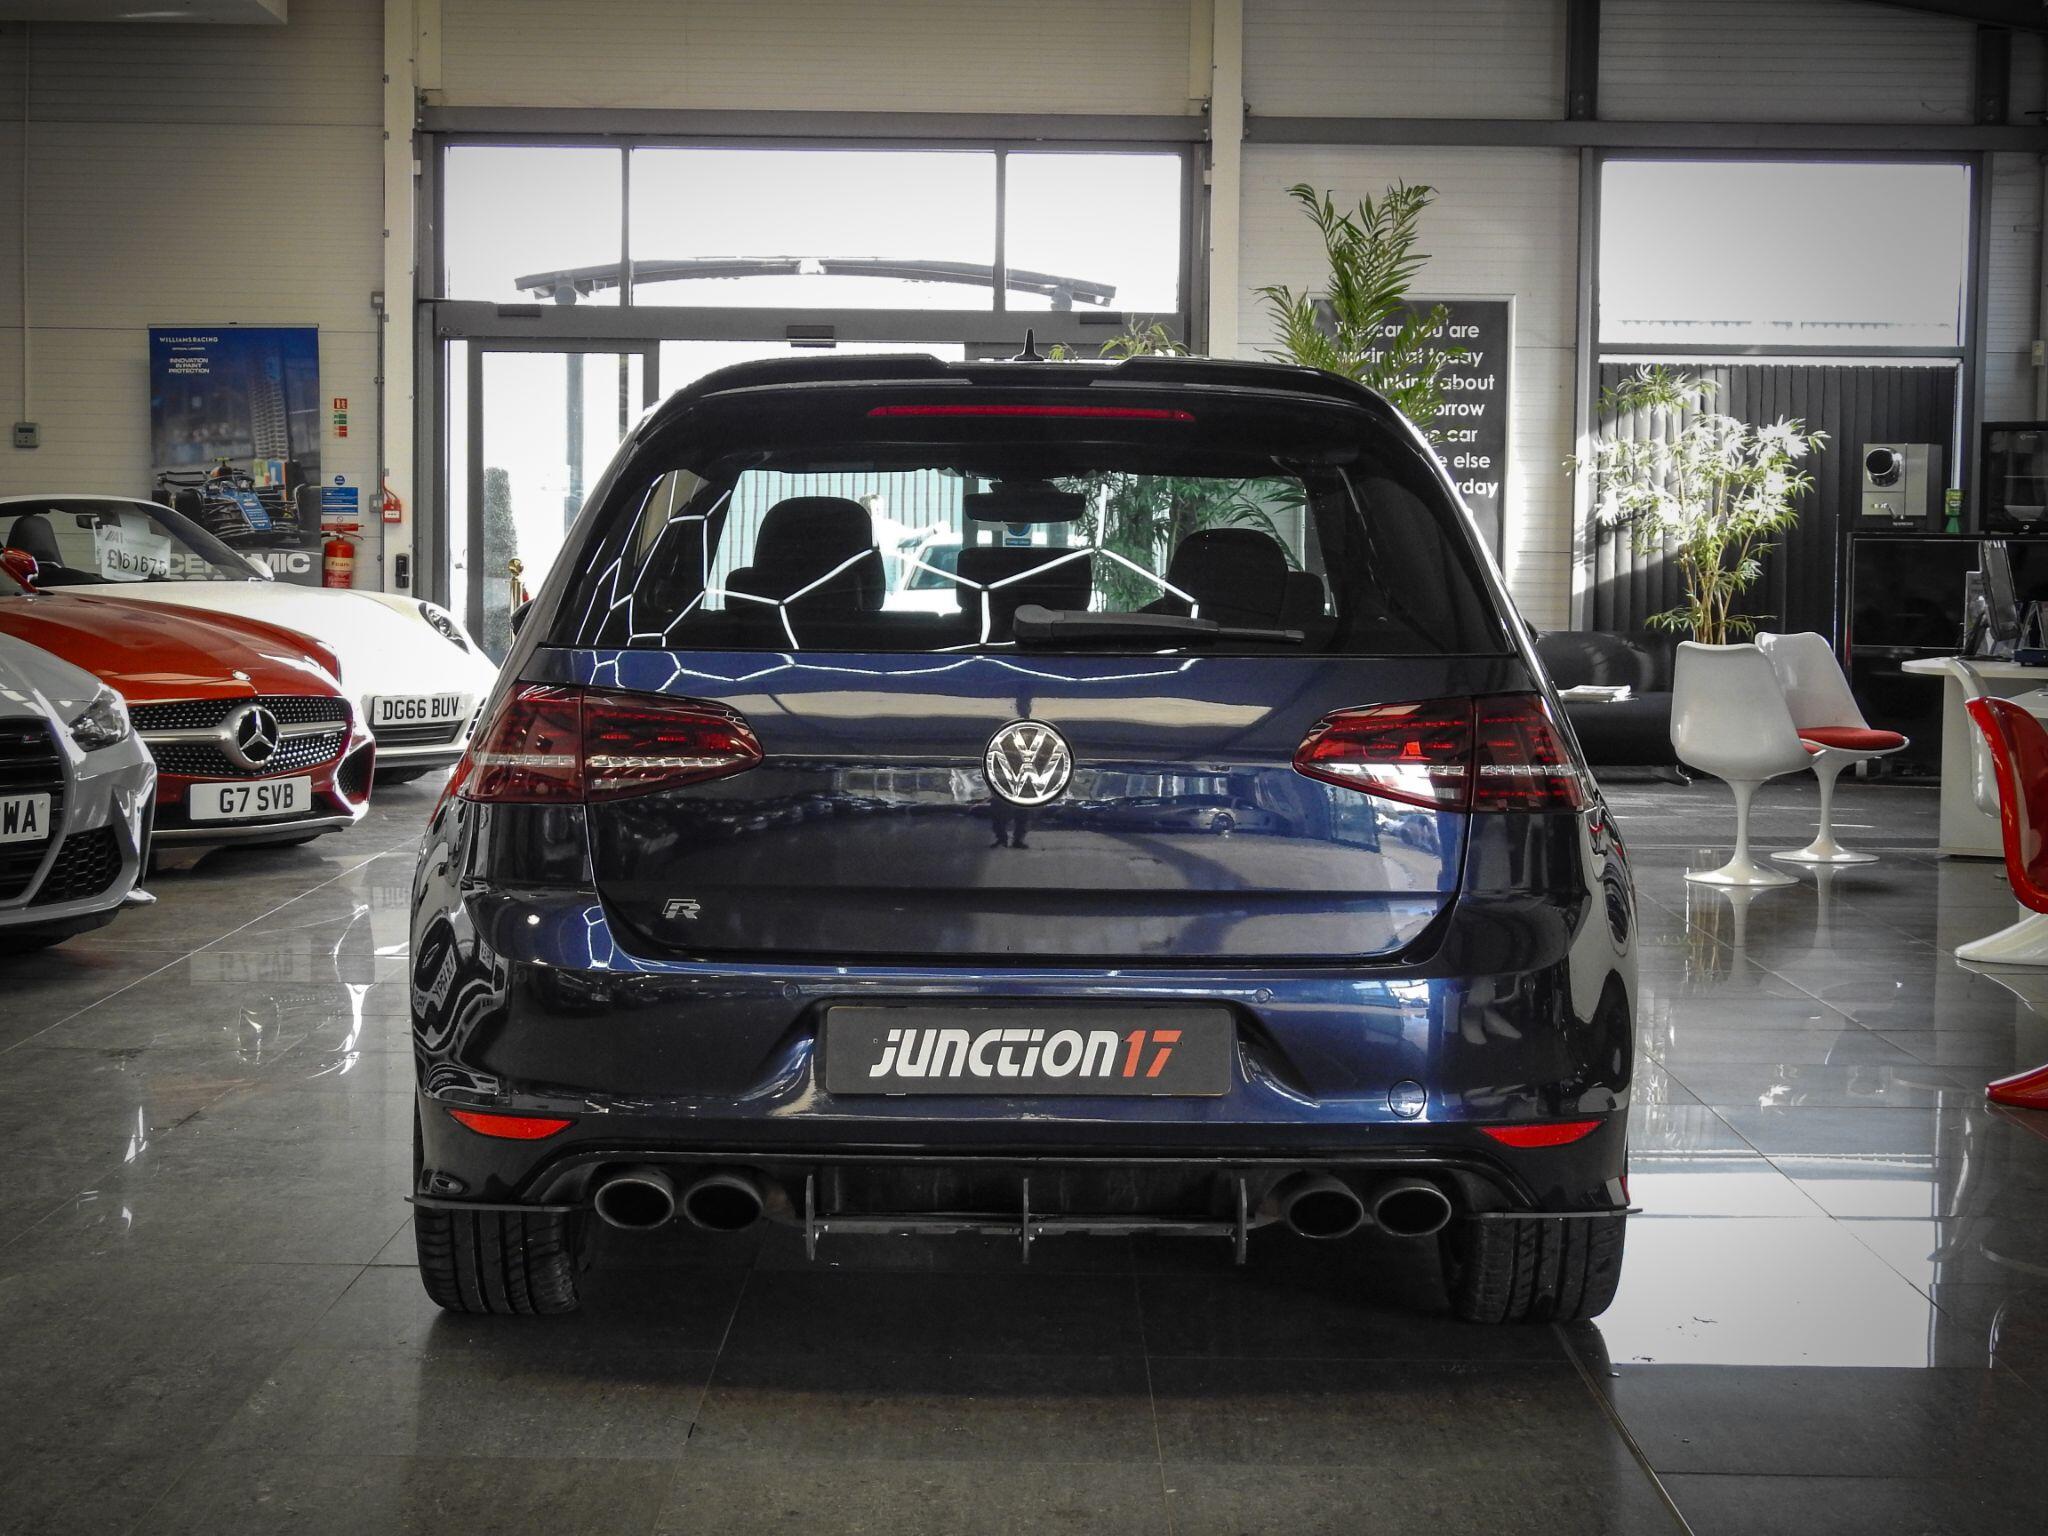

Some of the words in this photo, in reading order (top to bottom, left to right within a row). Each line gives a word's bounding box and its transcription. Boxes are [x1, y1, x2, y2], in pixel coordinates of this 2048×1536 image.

[1449, 325, 1480, 338] are
[1440, 373, 1495, 391] about
[1446, 429, 1478, 442] car
[1453, 451, 1491, 469] else
[382, 699, 427, 721] DG66
[431, 696, 460, 718] BUV
[219, 787, 251, 814] G7
[257, 783, 294, 811] SVB
[3, 800, 37, 835] WA
